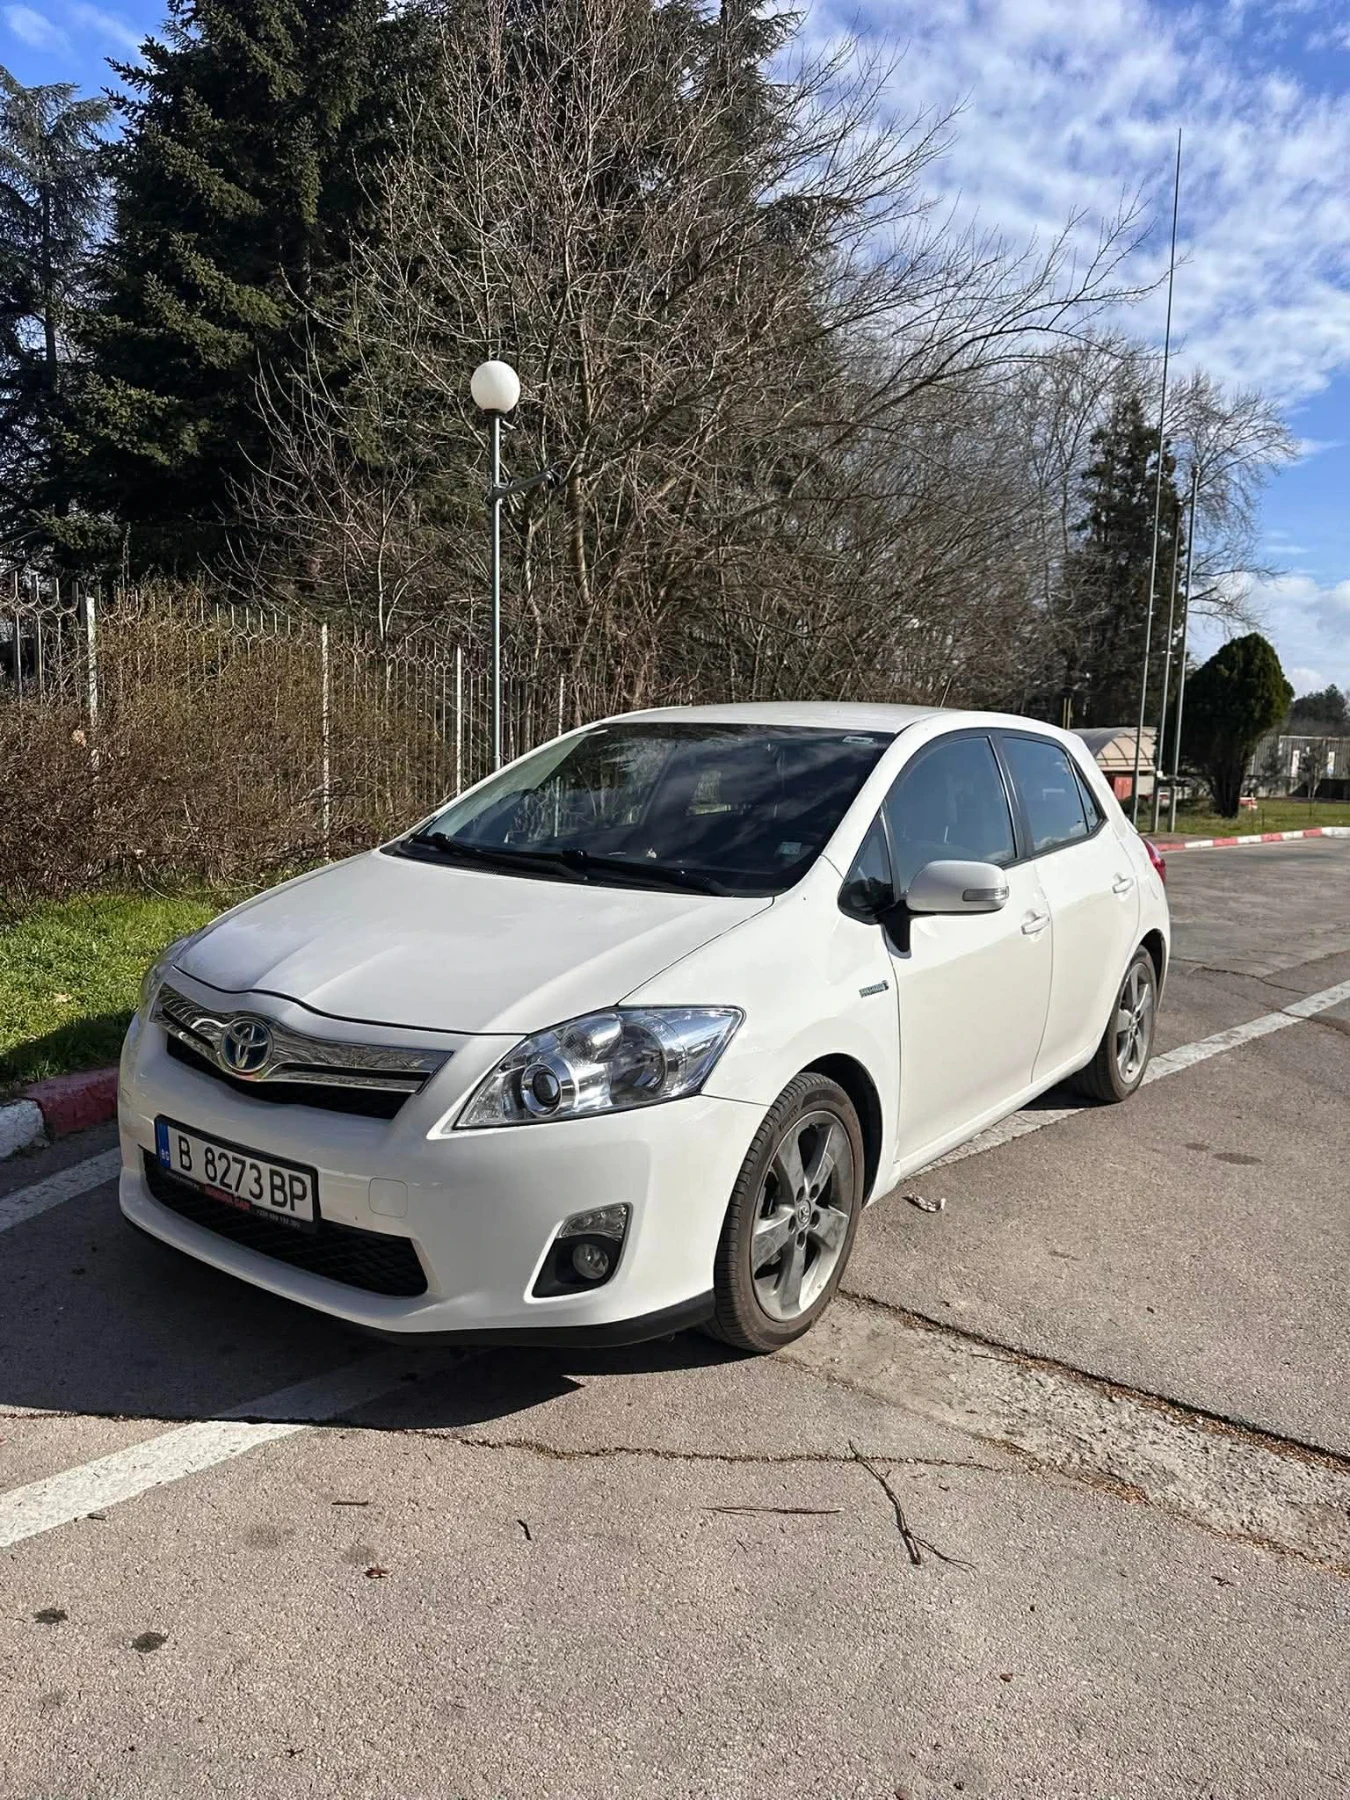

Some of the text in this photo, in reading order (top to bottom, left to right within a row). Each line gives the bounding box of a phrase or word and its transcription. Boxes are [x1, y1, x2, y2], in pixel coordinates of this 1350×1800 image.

[178, 1135, 192, 1172] B
[204, 1146, 264, 1200] 8273
[269, 1168, 307, 1212] BP
